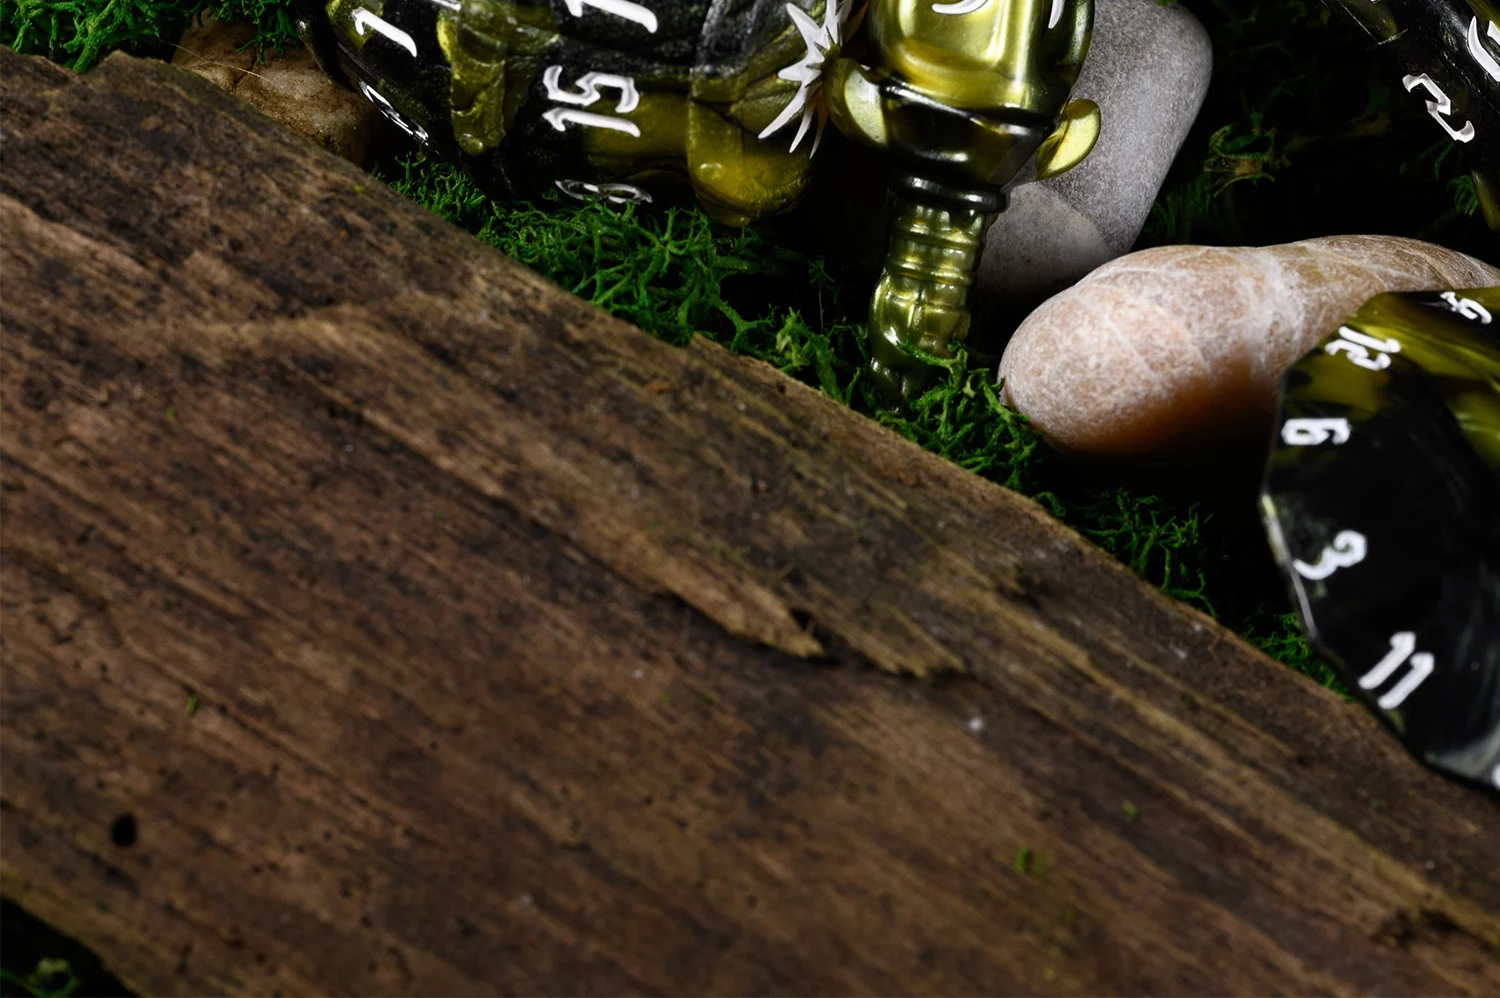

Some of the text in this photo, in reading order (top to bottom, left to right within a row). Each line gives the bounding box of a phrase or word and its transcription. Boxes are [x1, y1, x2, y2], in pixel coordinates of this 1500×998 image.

[350, 4, 421, 59] 1
[540, 64, 643, 139] 15
[1401, 71, 1477, 145] 2
[1322, 324, 1404, 372] 12
[1292, 528, 1368, 582] 3
[1356, 630, 1435, 711] 11
